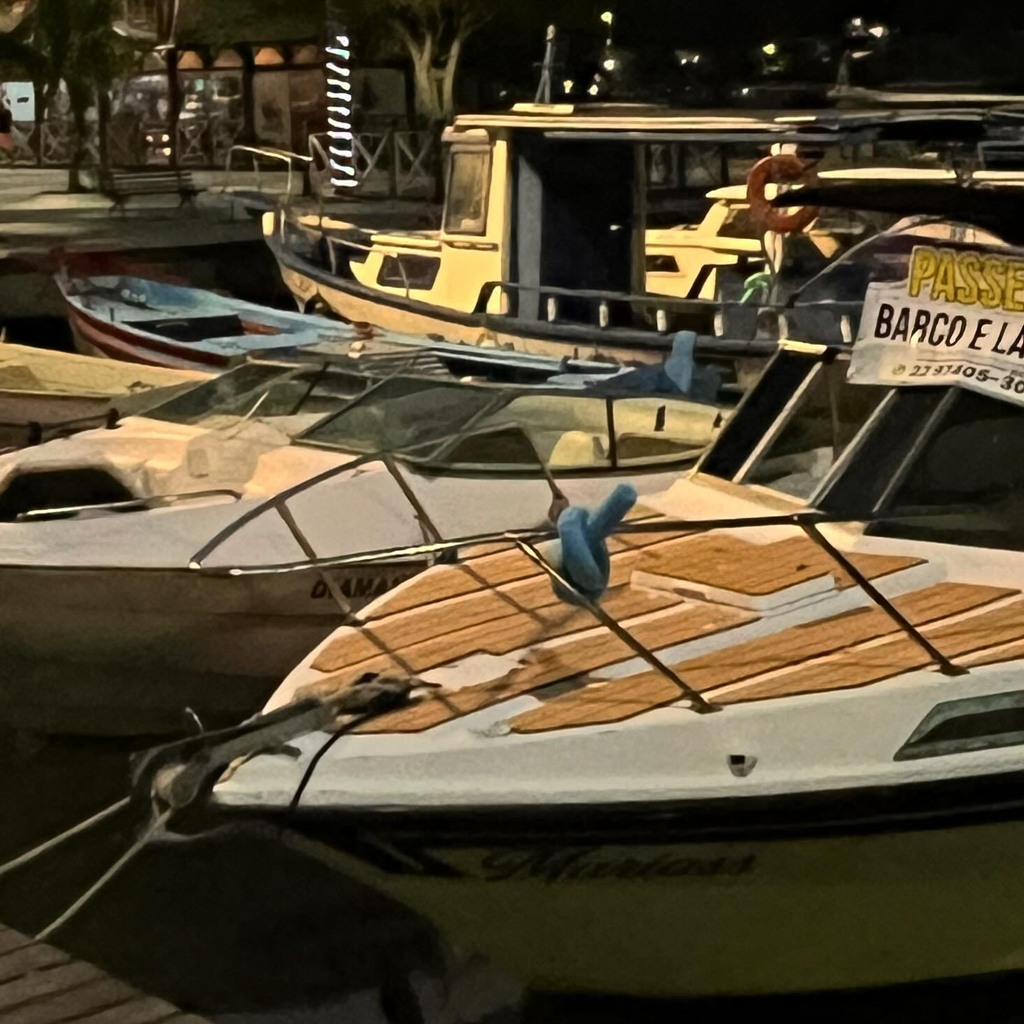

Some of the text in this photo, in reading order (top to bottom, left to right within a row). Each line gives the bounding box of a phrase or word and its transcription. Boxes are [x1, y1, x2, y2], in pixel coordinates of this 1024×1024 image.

[909, 246, 1024, 312] PASSE
[874, 303, 966, 347] BARCO
[968, 318, 993, 350] E
